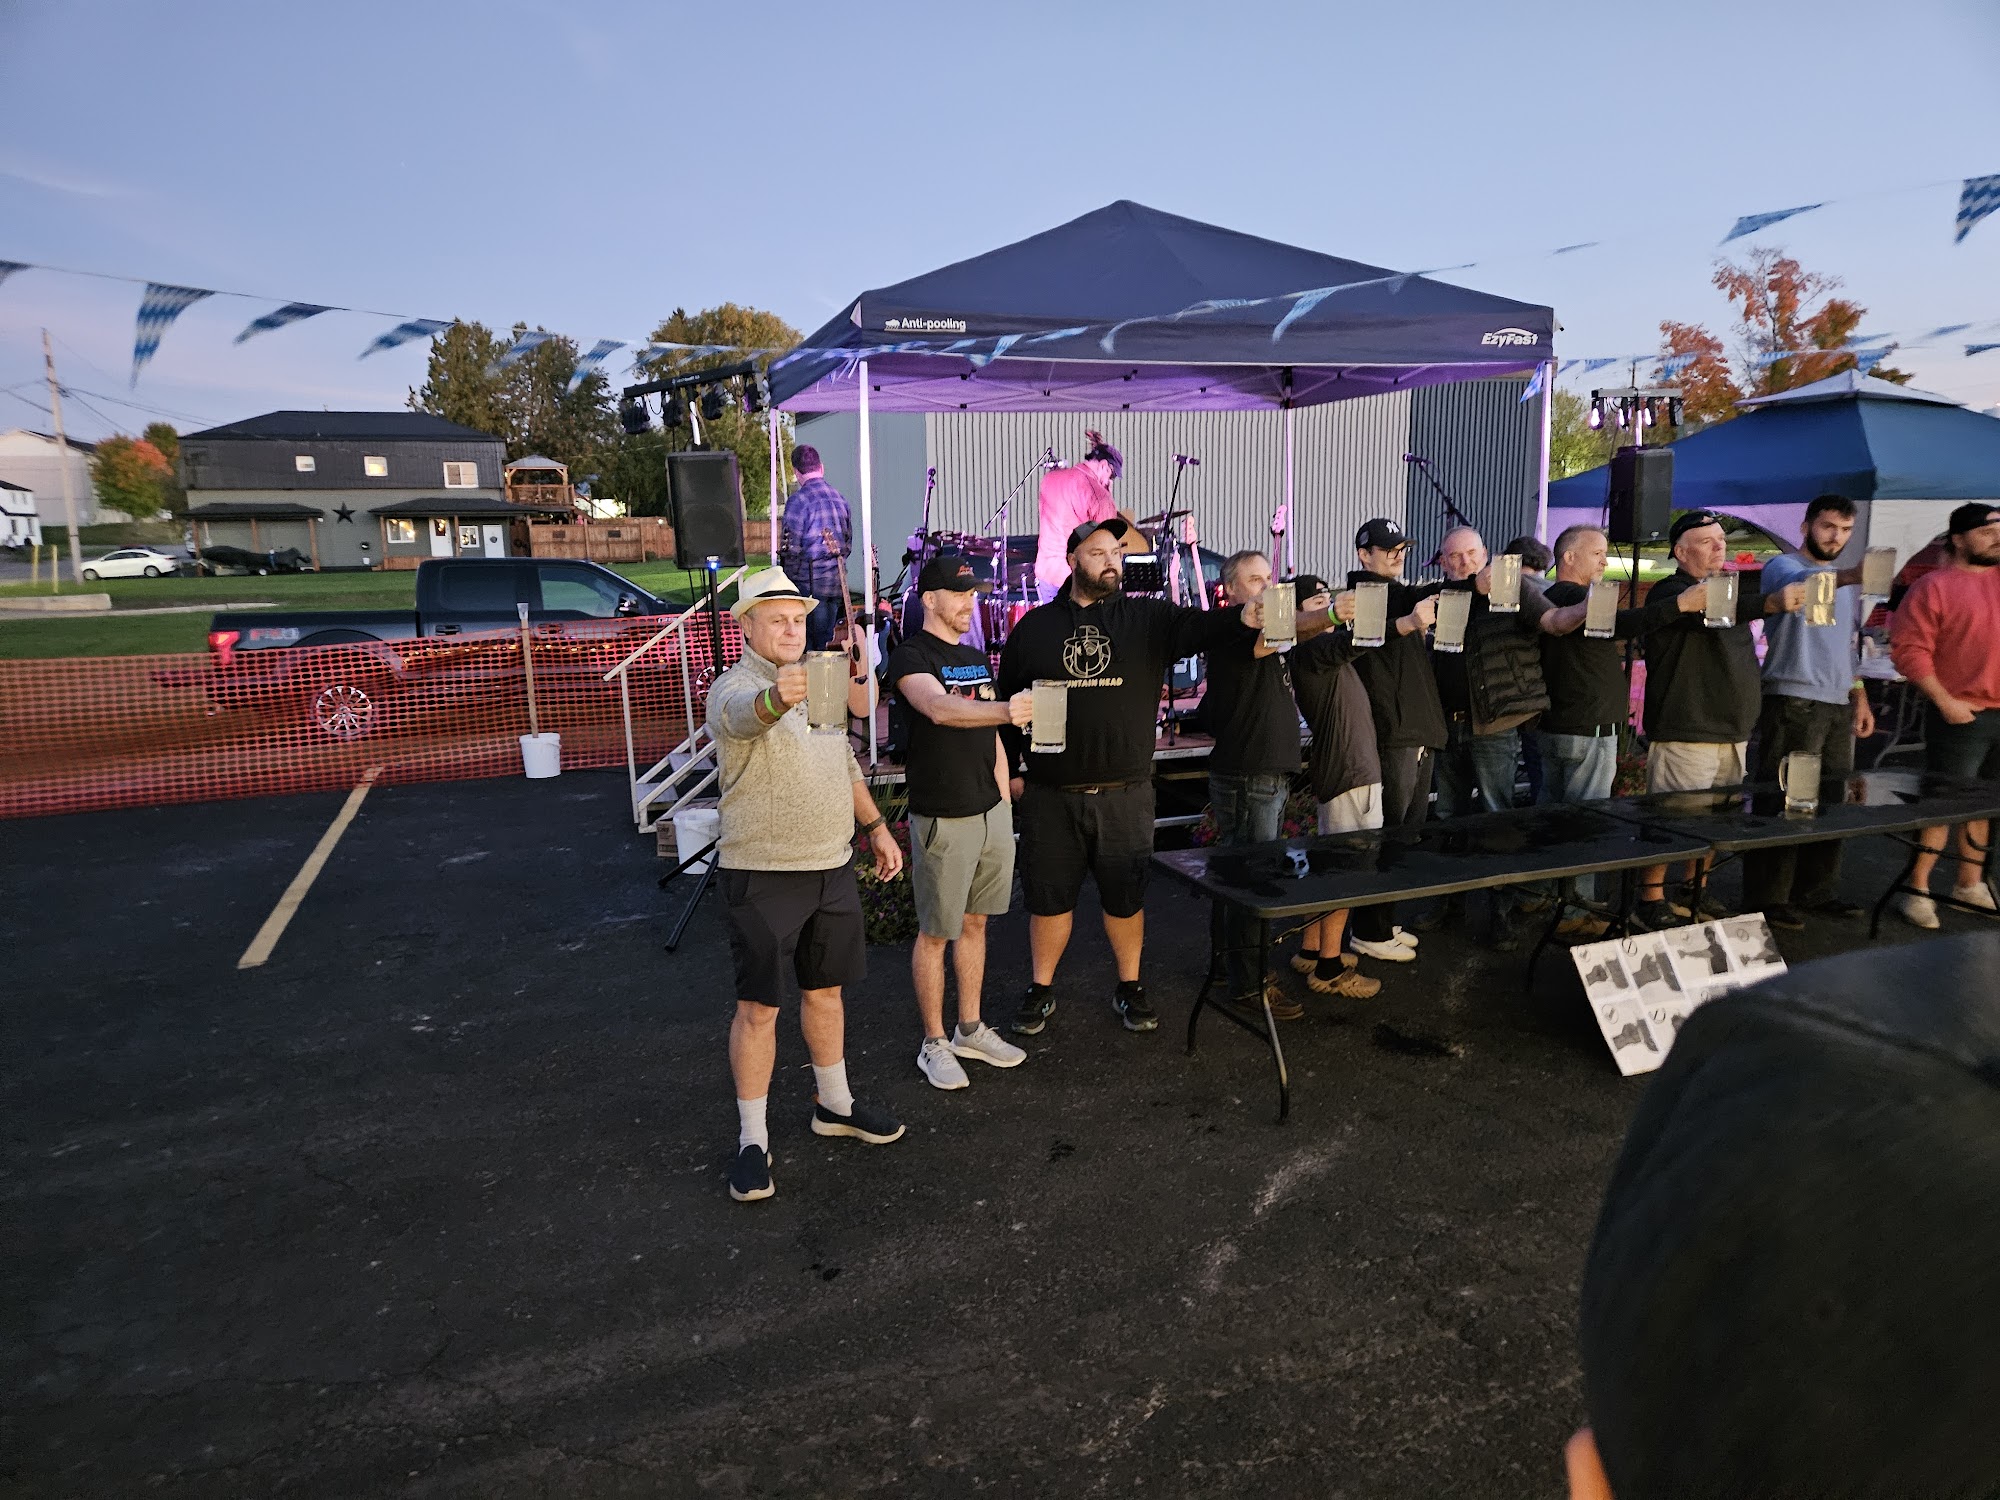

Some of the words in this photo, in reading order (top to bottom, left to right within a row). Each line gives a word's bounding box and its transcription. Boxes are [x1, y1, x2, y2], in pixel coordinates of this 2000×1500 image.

[901, 317, 966, 331] Anti-pooling
[1481, 333, 1538, 347] EzyFast
[1099, 677, 1123, 687] HEAD
